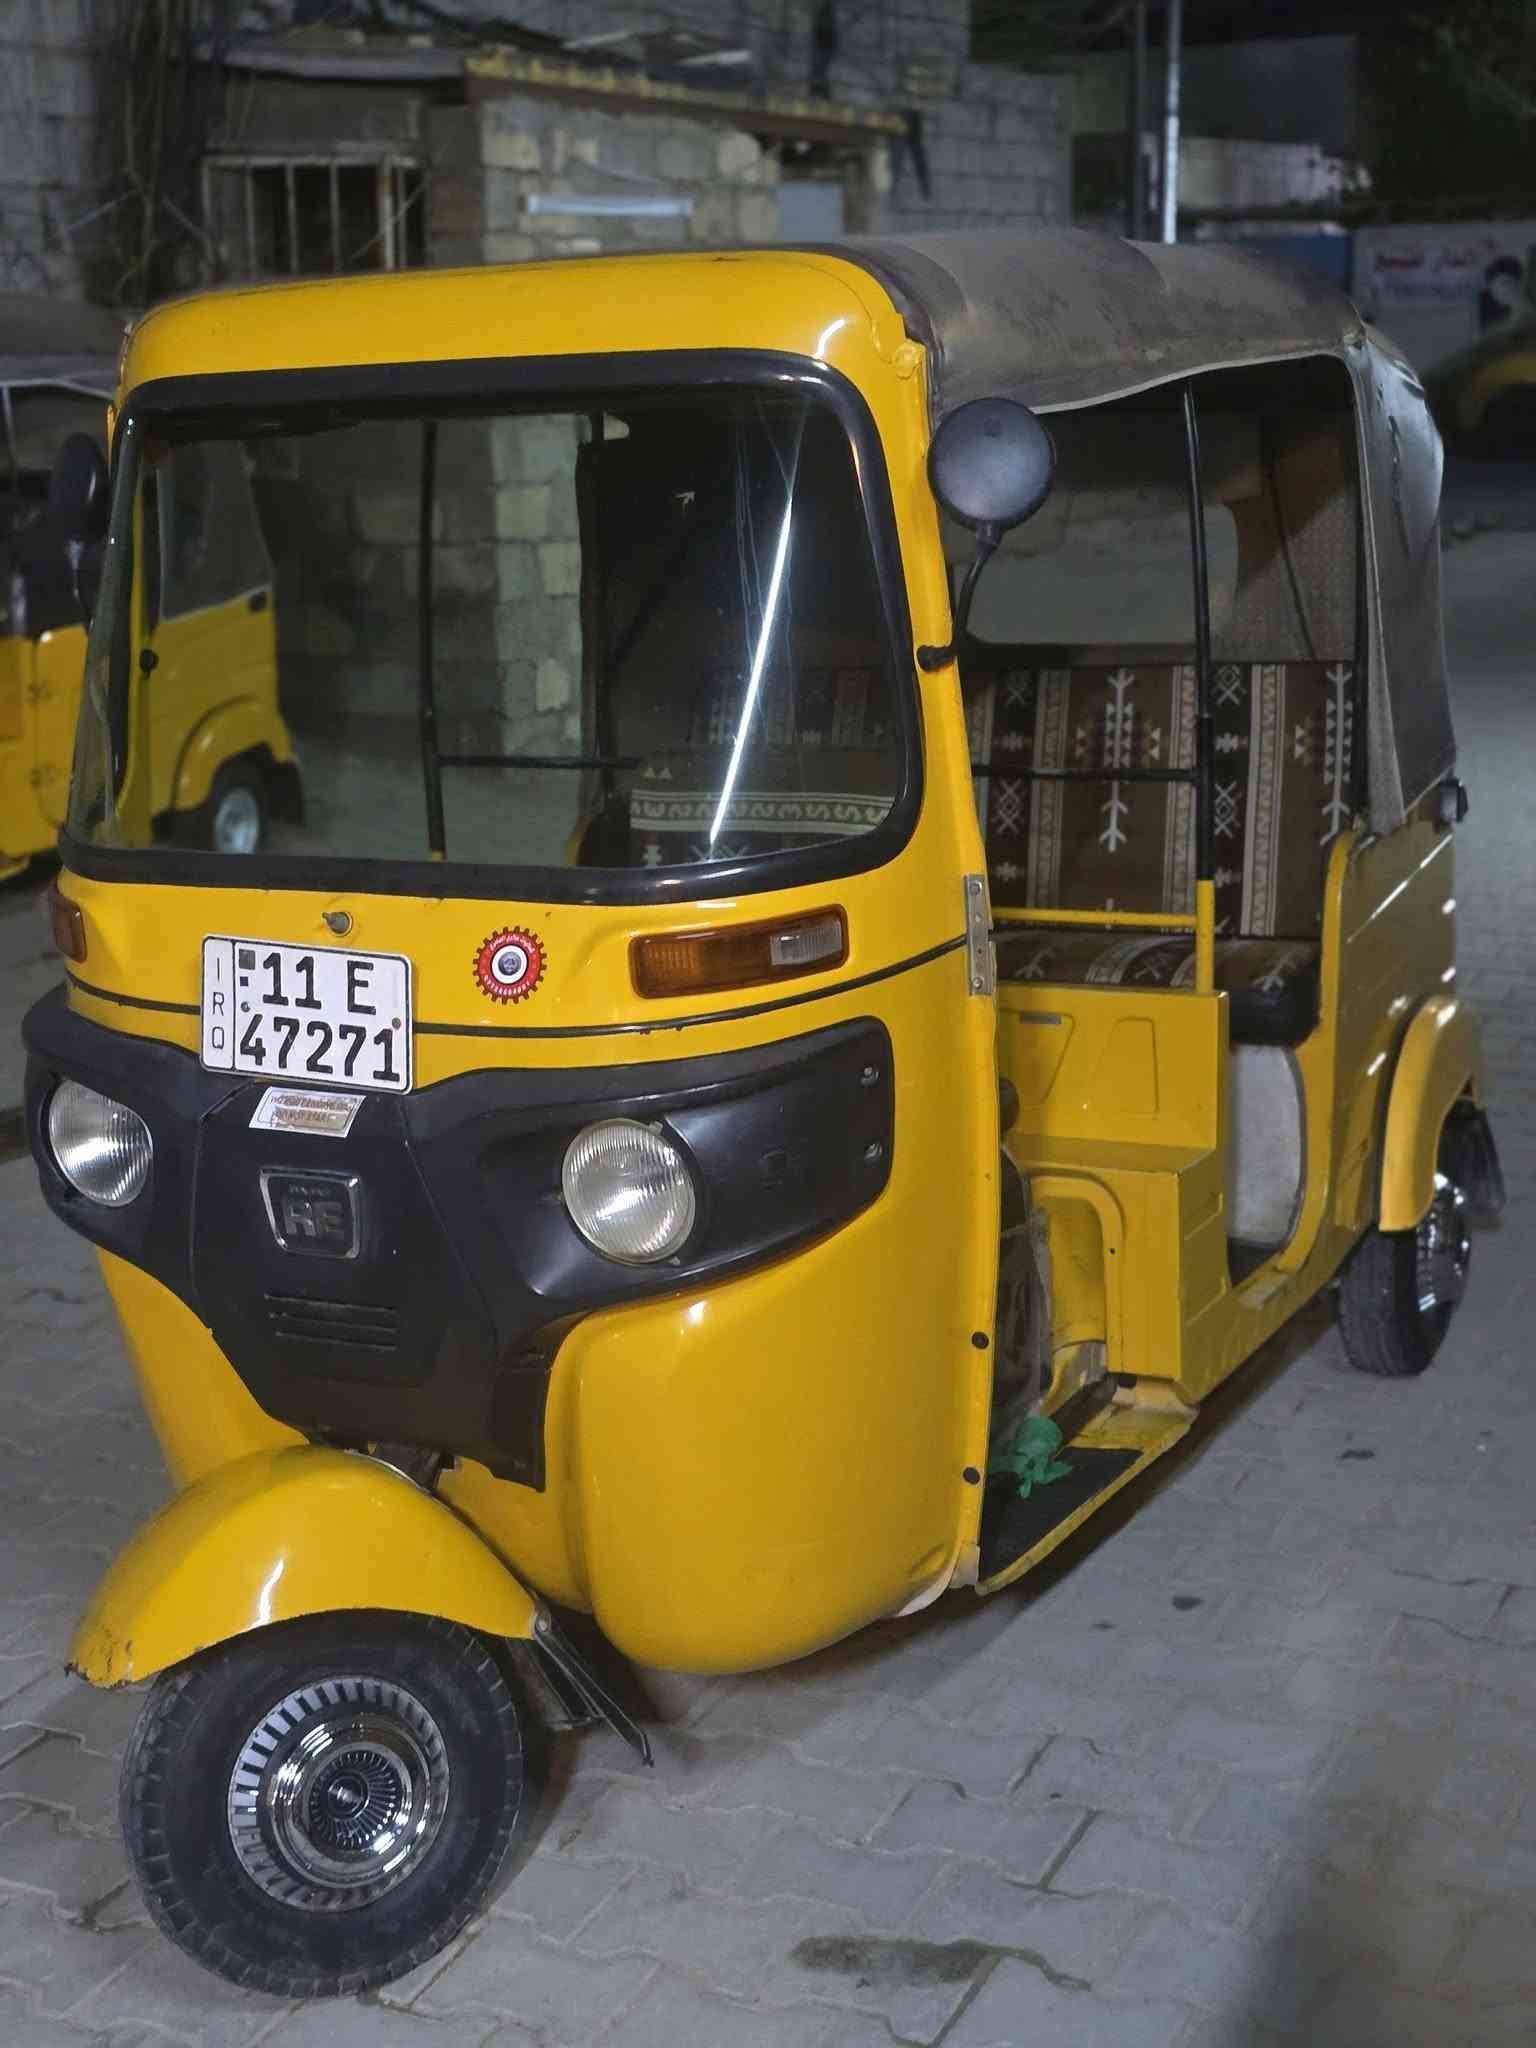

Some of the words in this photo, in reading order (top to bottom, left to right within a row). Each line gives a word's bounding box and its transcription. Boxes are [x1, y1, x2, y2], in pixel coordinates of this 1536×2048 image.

[211, 956, 225, 1050] IRQ
[262, 952, 322, 1010] 11
[346, 959, 377, 1016] E
[239, 1013, 401, 1083] 47271
[281, 1195, 345, 1239] RE
